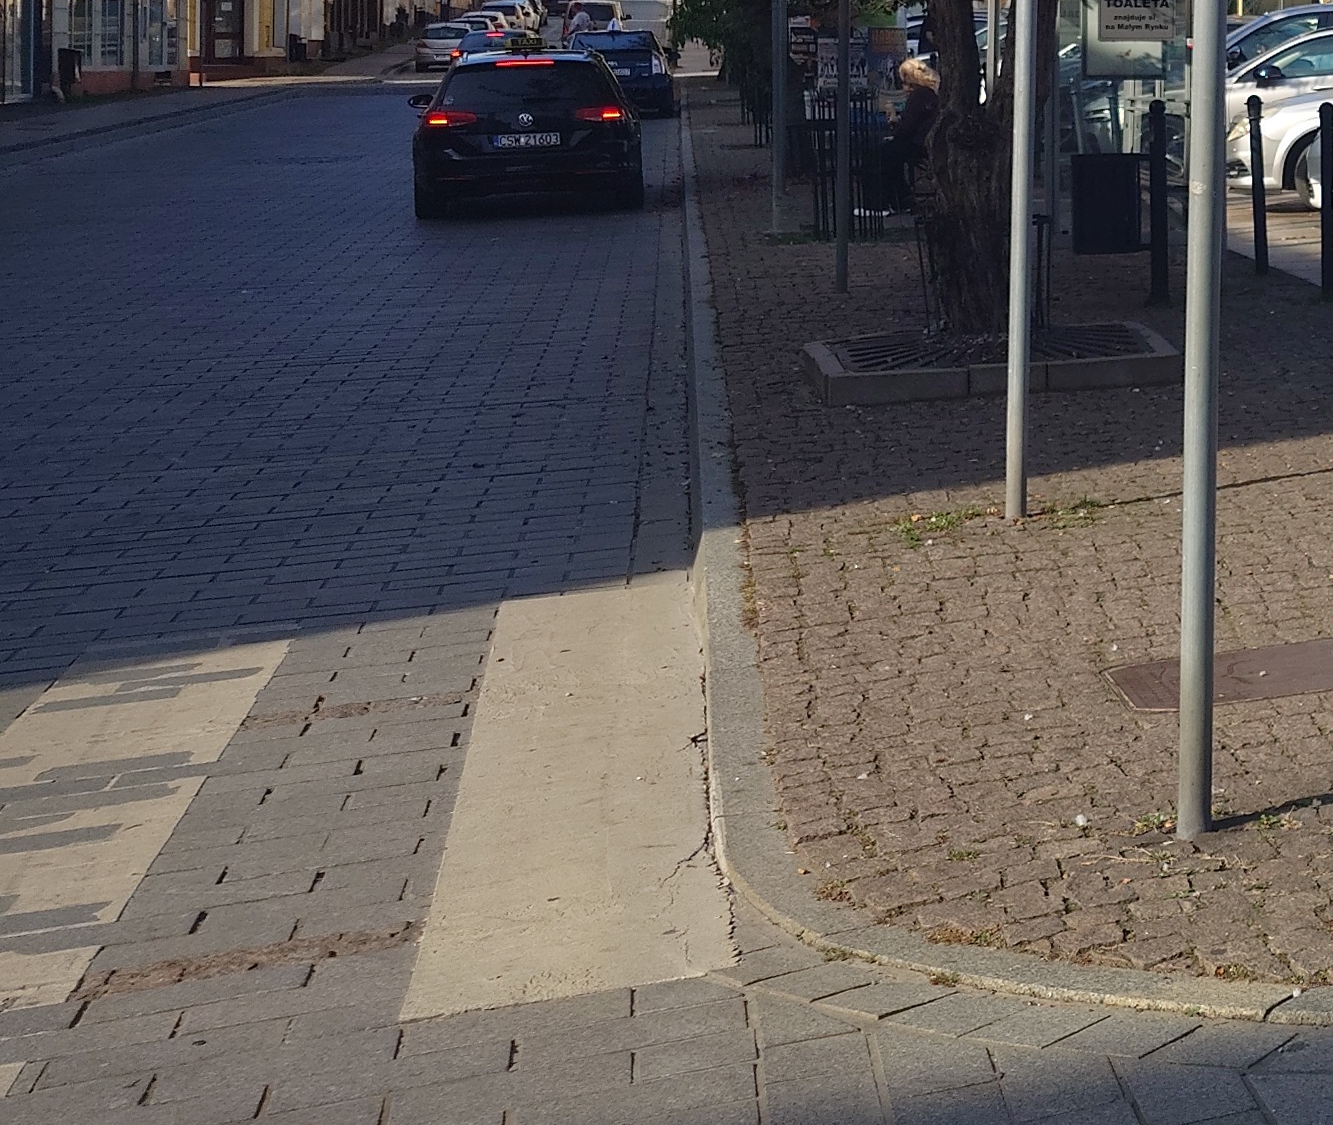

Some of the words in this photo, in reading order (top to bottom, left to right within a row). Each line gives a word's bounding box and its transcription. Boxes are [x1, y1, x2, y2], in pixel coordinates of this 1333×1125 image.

[1113, 14, 1146, 22] znajduje
[517, 38, 537, 46] TAXI
[524, 134, 559, 145] 21603
